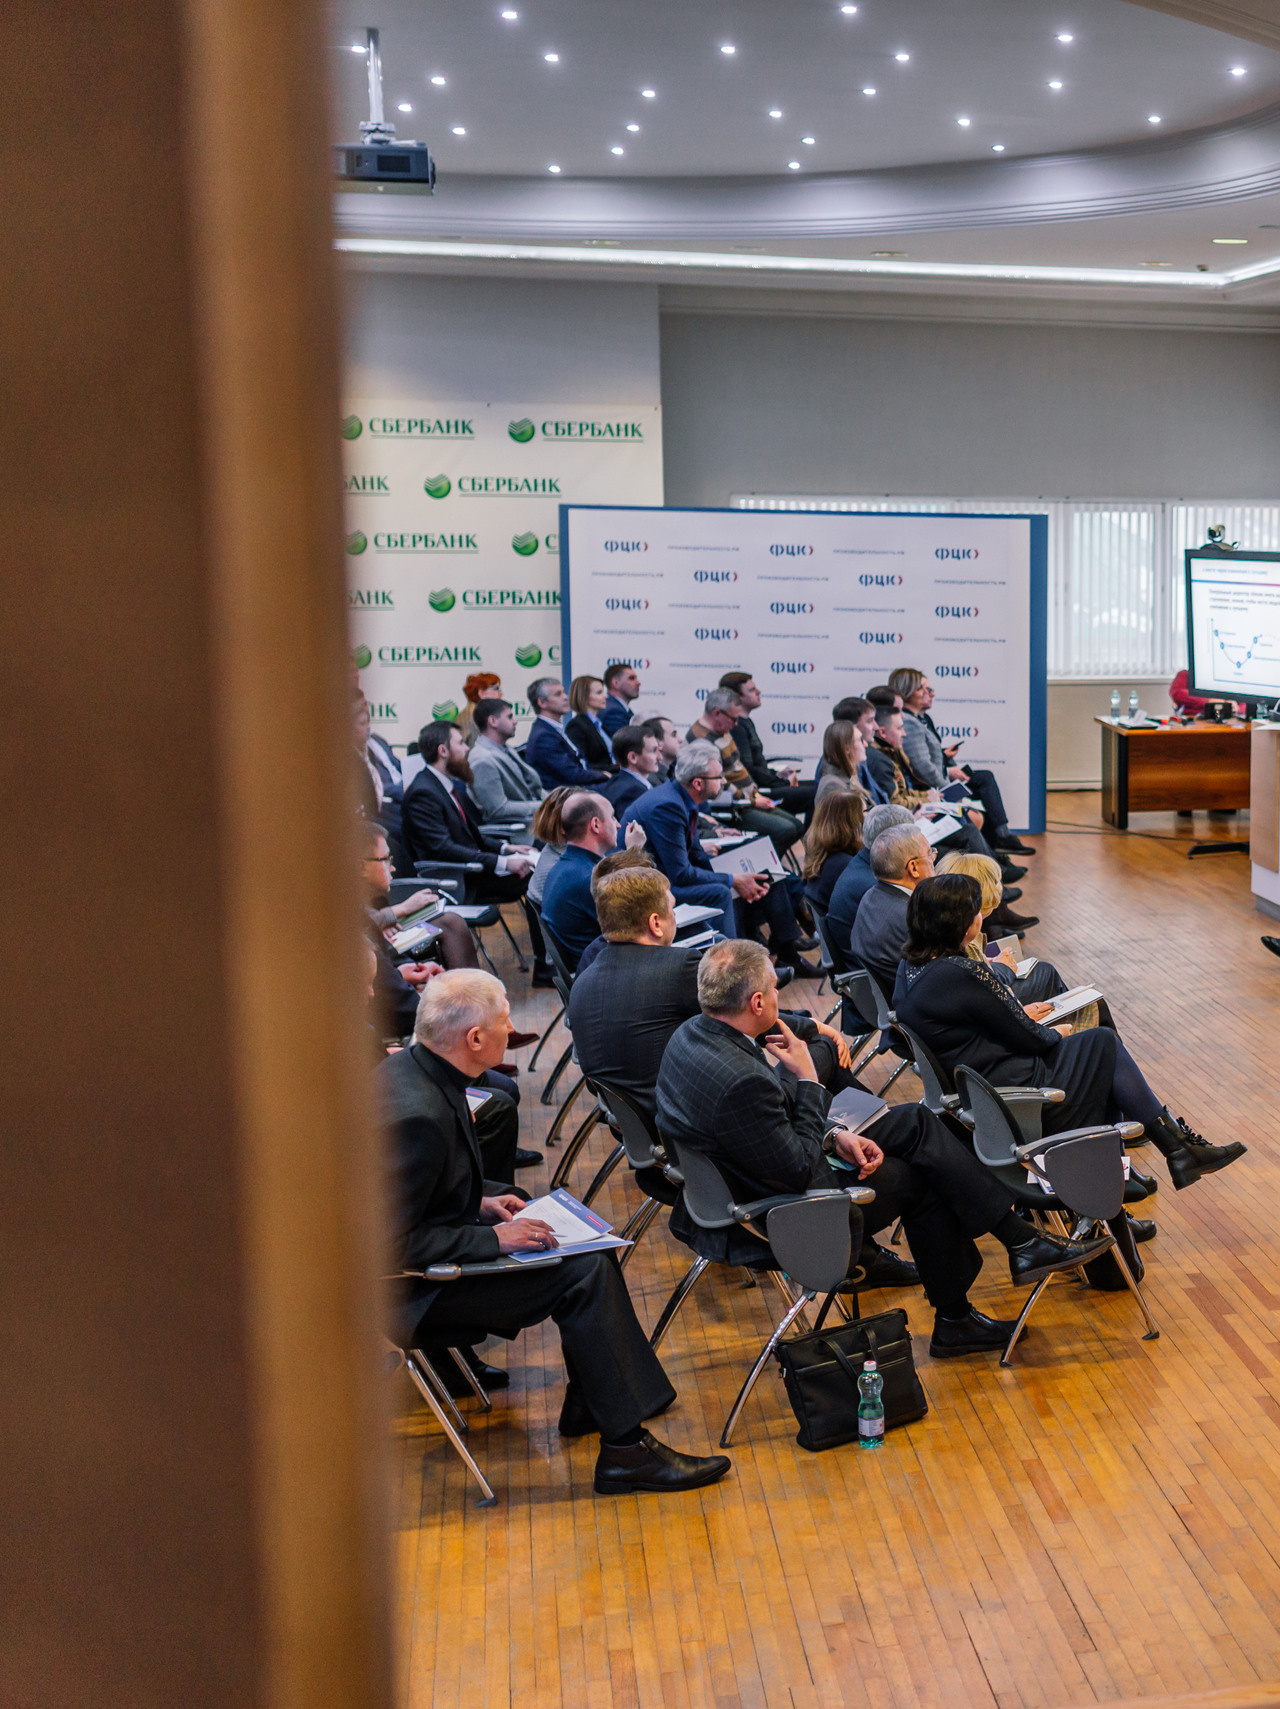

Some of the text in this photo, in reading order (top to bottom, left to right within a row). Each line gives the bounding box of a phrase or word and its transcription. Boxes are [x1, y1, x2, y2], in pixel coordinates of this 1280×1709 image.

[368, 417, 475, 435] СБЕРБАНК
[541, 420, 643, 438] СБЕРБАНК
[458, 476, 561, 493] СБЕРБАНК
[373, 533, 478, 549] СБЕРБАНК
[462, 589, 561, 605] СБЕРБАНК
[378, 646, 481, 662] СБЕРБАНК
